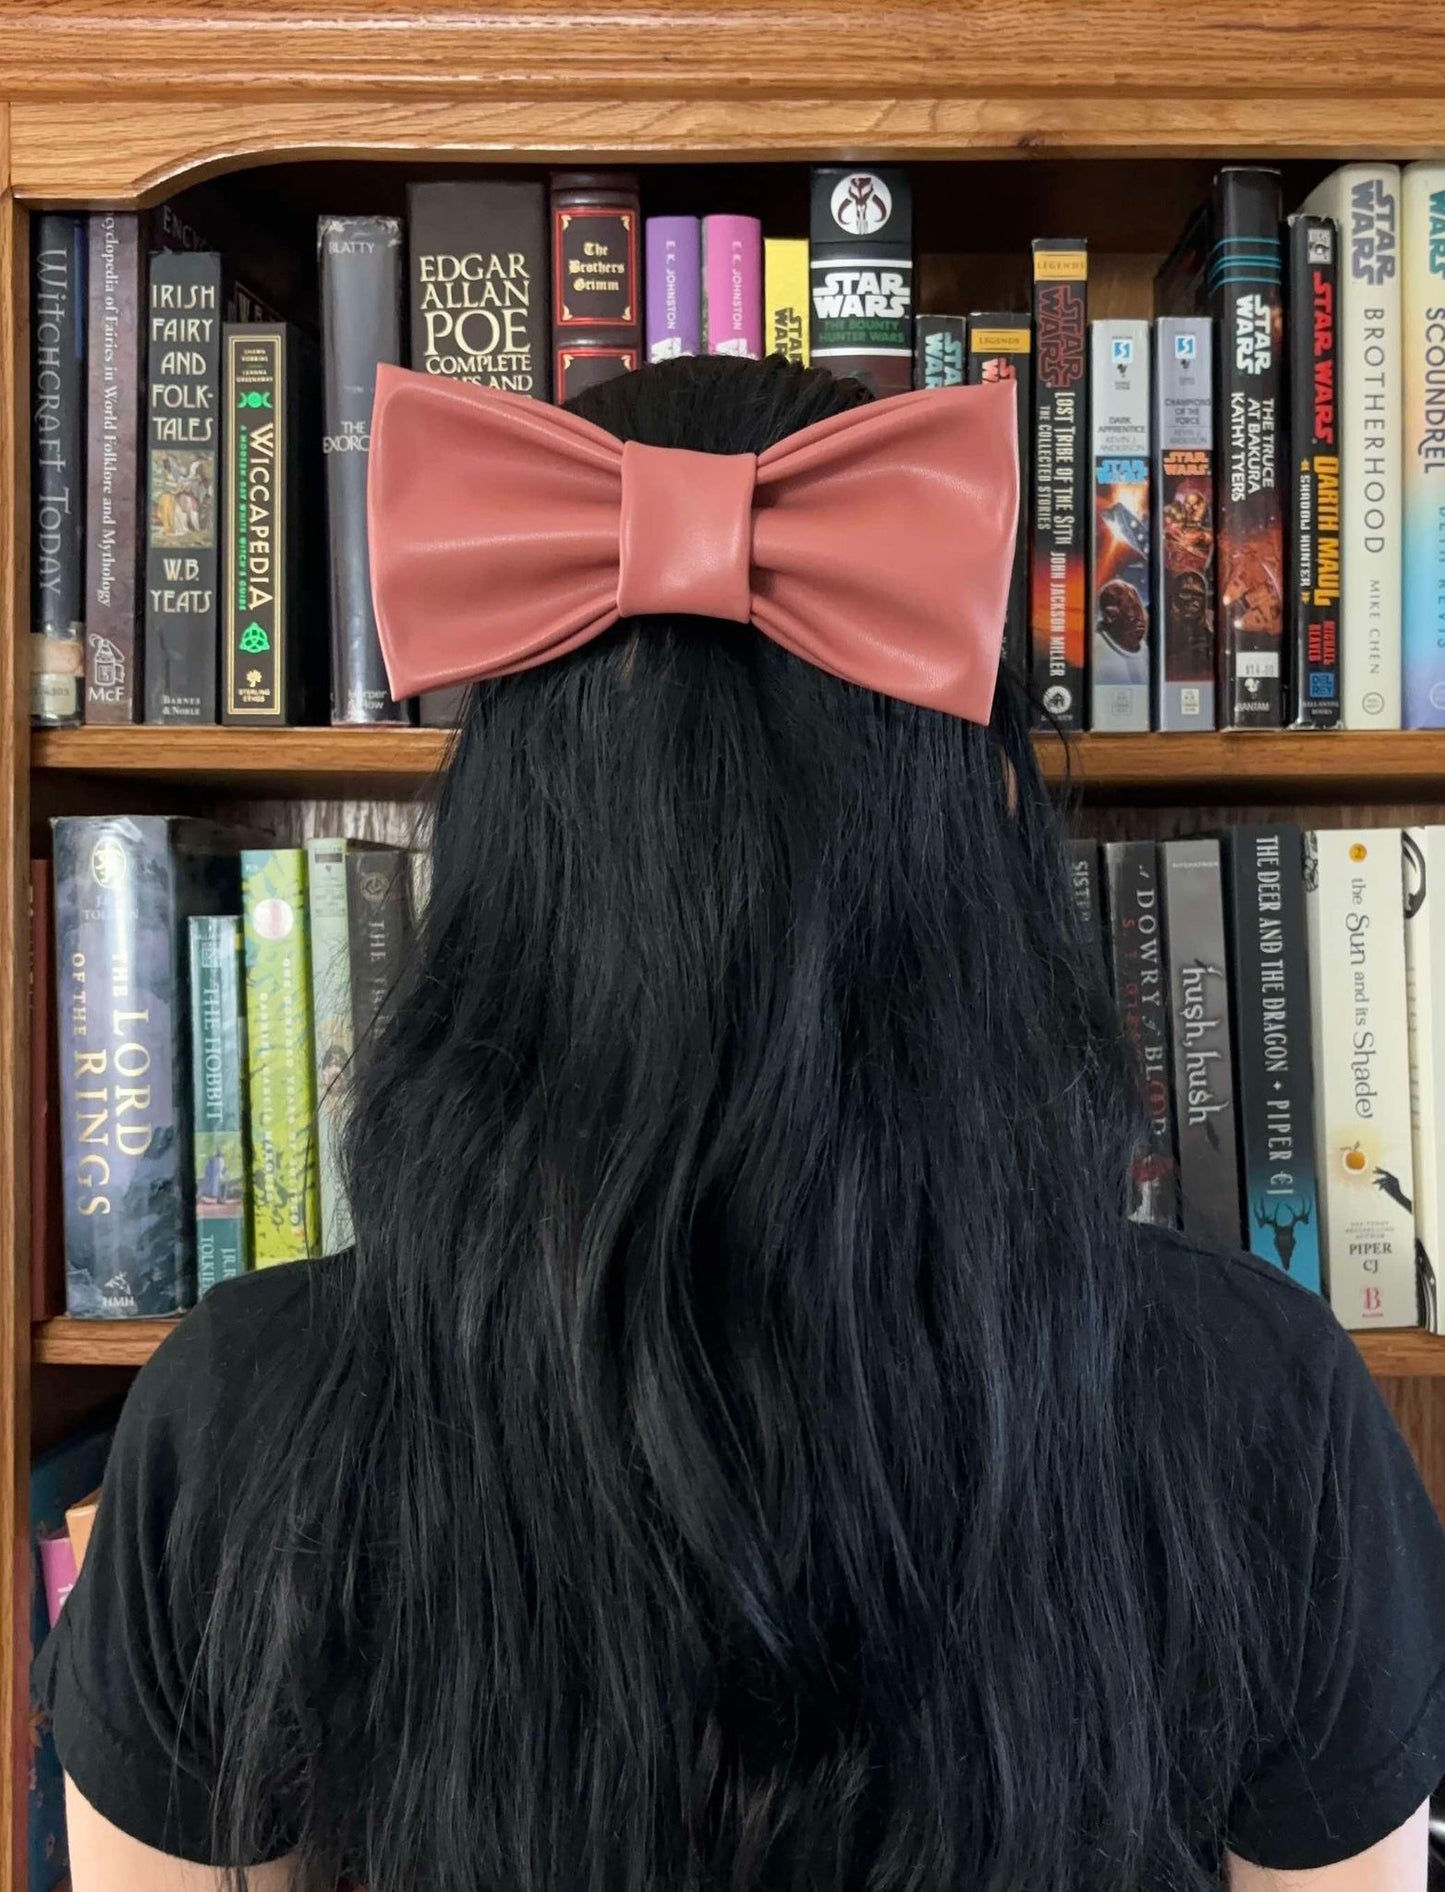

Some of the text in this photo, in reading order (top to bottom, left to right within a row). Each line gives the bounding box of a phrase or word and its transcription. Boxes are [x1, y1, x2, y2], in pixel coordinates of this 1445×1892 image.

[583, 242, 609, 256] The
[1351, 179, 1374, 285] WARS
[1374, 179, 1395, 286] STAR
[419, 253, 530, 282] EDGAR
[568, 259, 625, 274] Brothers
[573, 278, 620, 291] Grimm
[812, 271, 911, 296] STAR
[1037, 261, 1084, 270] LEGENDS
[104, 297, 118, 313] of
[152, 284, 215, 310] IRISH
[420, 280, 530, 309] ALLAN
[666, 269, 681, 330] JOHNSTON
[733, 269, 744, 331] JOHNSTON
[812, 294, 910, 318] WARS
[1313, 270, 1333, 356] STAR
[104, 314, 118, 362] Fairies
[152, 318, 214, 343] FAIRY
[424, 308, 531, 357] POE
[979, 337, 1020, 345] LEGENDS
[1039, 285, 1061, 388] WARS
[1061, 284, 1084, 388] STAR
[1236, 294, 1254, 374] WARS
[1254, 294, 1271, 375] STAR
[104, 365, 118, 380] in
[160, 352, 207, 376] AND
[426, 354, 533, 375] COMPLETE
[487, 375, 533, 391] AND
[104, 384, 118, 430] World
[152, 384, 214, 410] FOLK-
[1314, 358, 1334, 445] WARS
[152, 417, 214, 442] TALES
[341, 421, 366, 434] THE
[1231, 392, 1246, 502] KATHY TYERS
[1247, 398, 1261, 494] AT BAKURA
[1262, 398, 1274, 488] THE TRUCE
[1364, 308, 1385, 553] BROTHERHOOD
[102, 433, 117, 495] Folklore
[1037, 405, 1052, 530] THE COLLECTED STORIES
[1053, 392, 1076, 545] LOST TRIBE OF THE SITH
[1163, 451, 1209, 464] STAR
[1164, 463, 1209, 476] WARS
[102, 498, 117, 526] and
[248, 422, 274, 611] WICCAPEDIA
[1299, 474, 1311, 588] SHADOW HUNTER
[1314, 455, 1340, 607] DARTH MAUL
[38, 488, 71, 595] TODAY
[97, 528, 117, 608] Mythology
[151, 590, 213, 614] YEATS
[1050, 552, 1067, 677] JOHN JACKSON MILLER
[1369, 579, 1381, 675] MIKE CHEN
[88, 687, 125, 702] McF
[1256, 835, 1280, 867] THE
[1257, 871, 1282, 912] DEER
[1136, 888, 1161, 1007] DOWRY
[1259, 917, 1283, 954] AND
[1260, 959, 1285, 993] THE
[1345, 877, 1378, 1119] the Sun and its Shade
[203, 984, 222, 1030] THE
[111, 953, 152, 1156] THE LORD
[1180, 966, 1229, 1126] hush, hush
[1262, 997, 1289, 1072] DRAGON
[71, 952, 111, 1215] OF THE RINGS
[204, 1037, 224, 1123] HOBBIT
[1266, 1099, 1293, 1161] PIPER
[1348, 1242, 1393, 1255] PIPER
[1362, 1259, 1379, 1274] CJ
[103, 1296, 134, 1307] HMH
